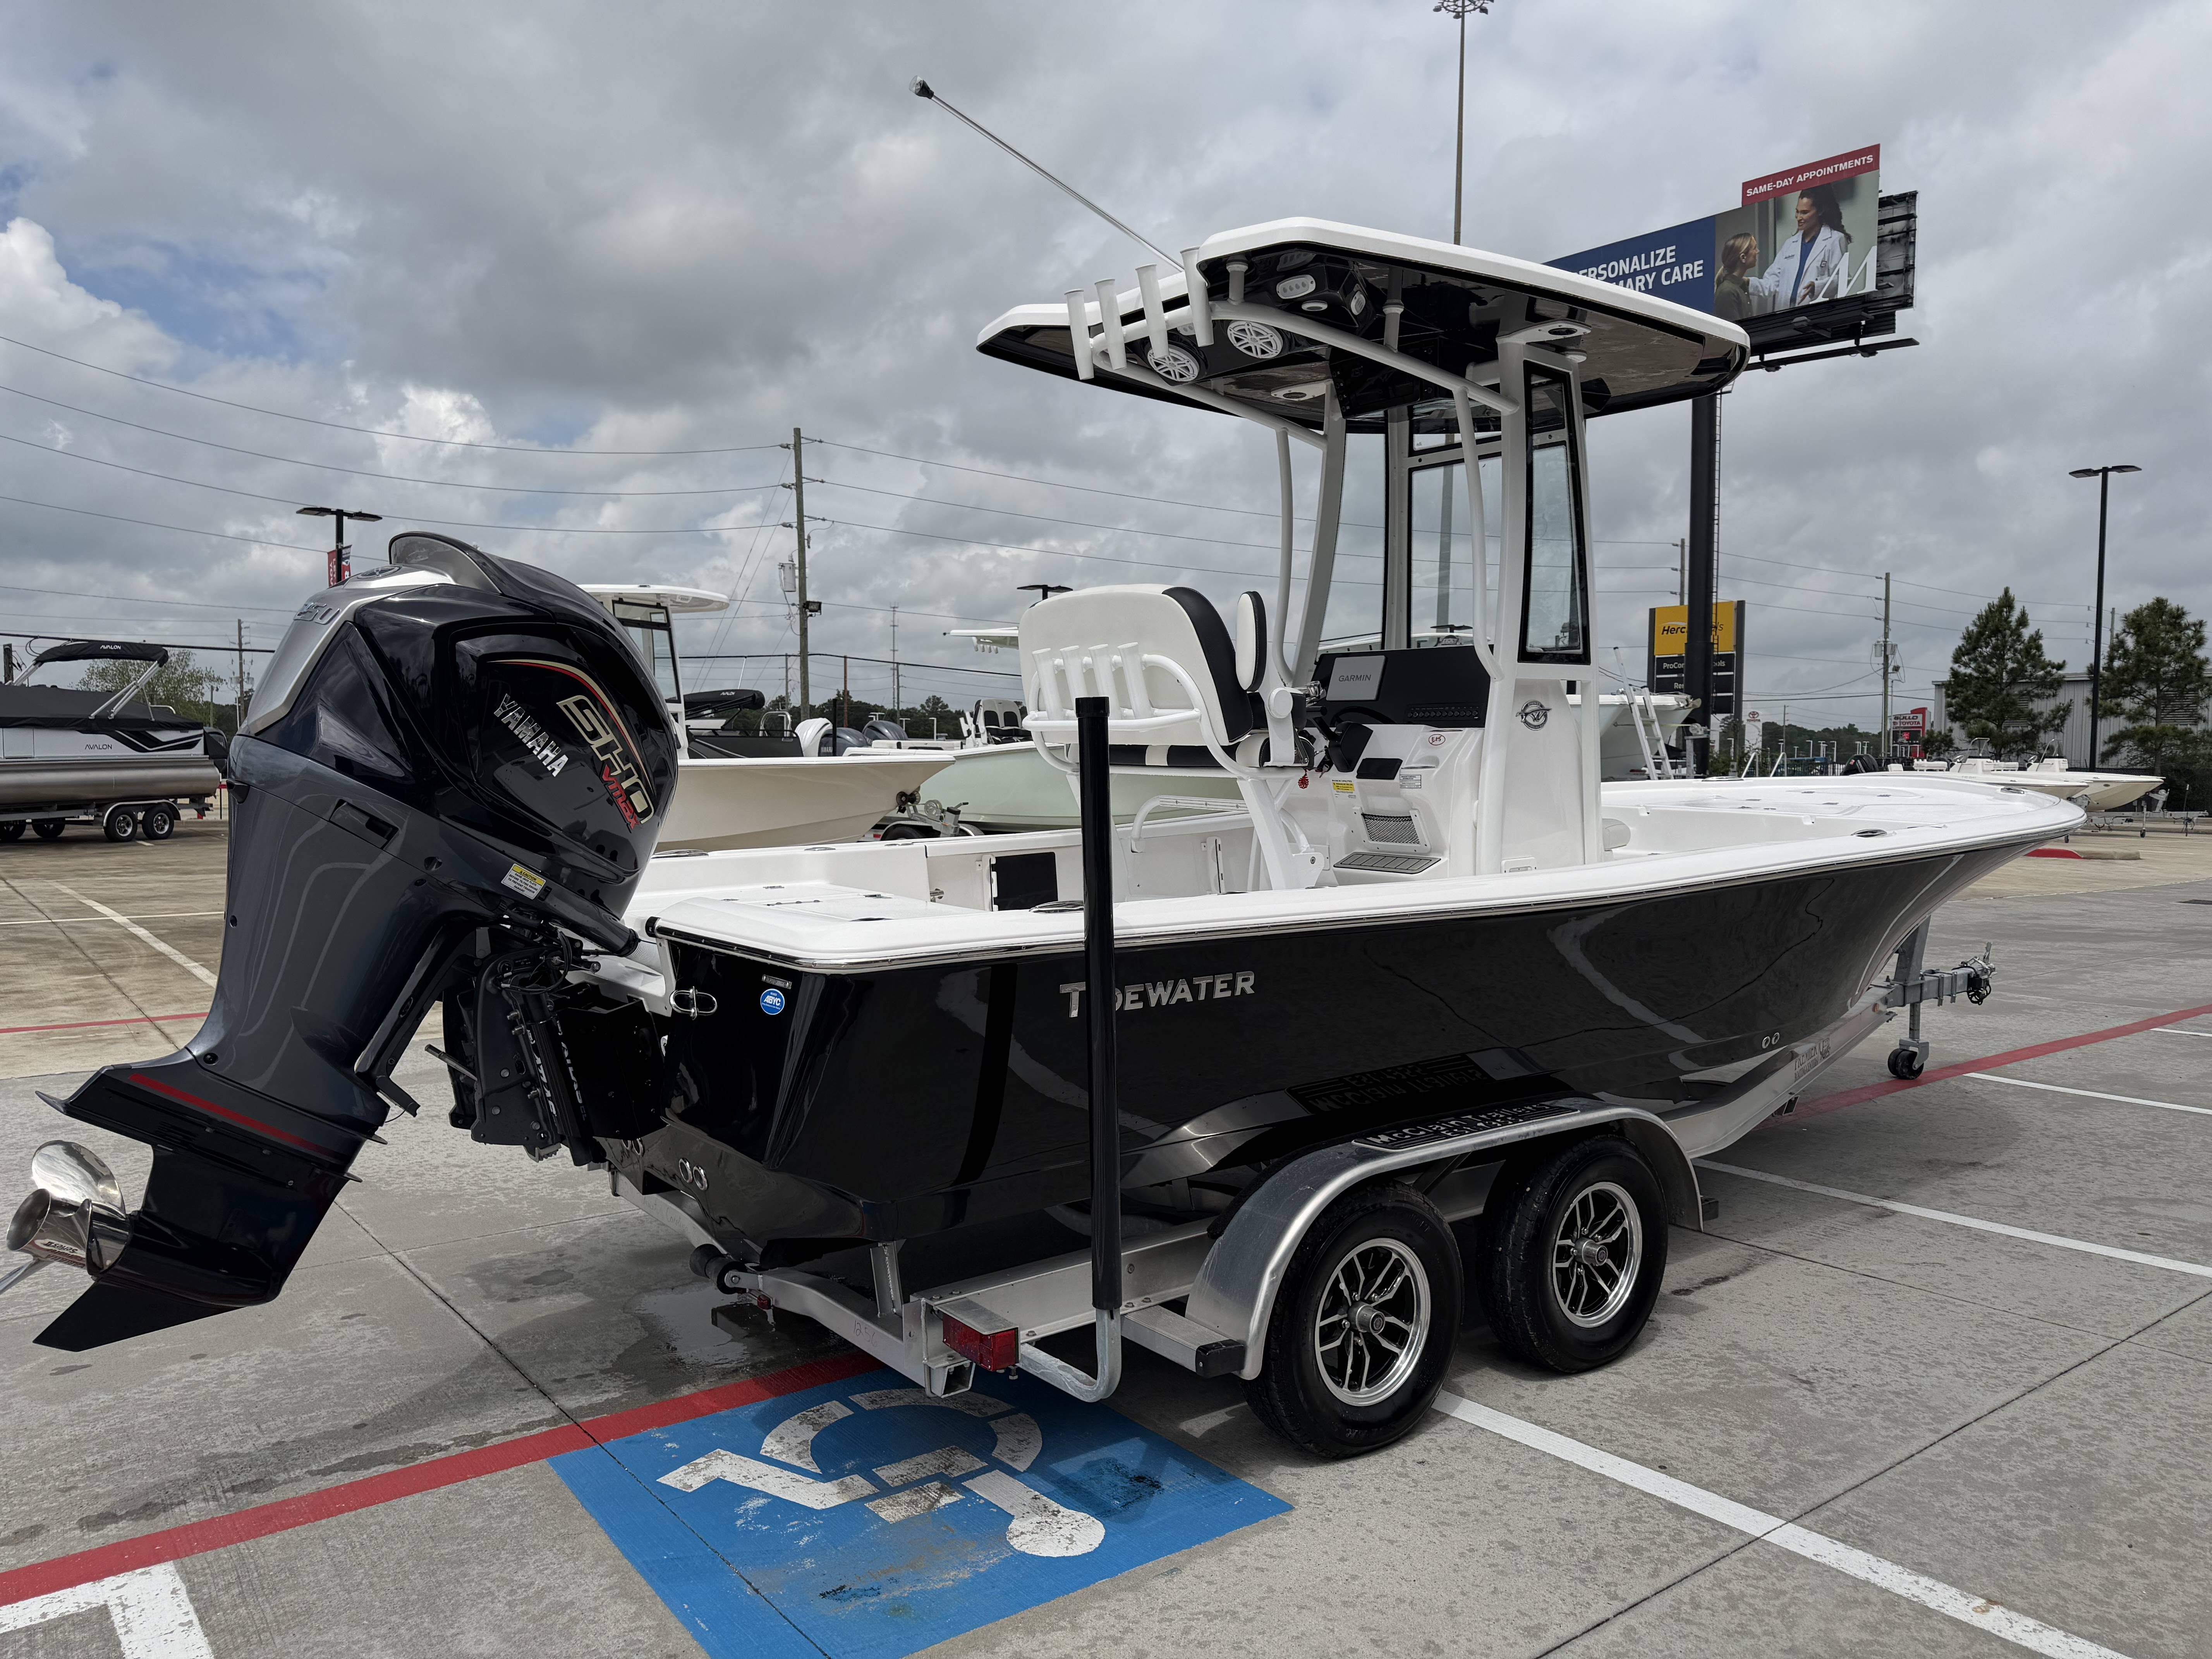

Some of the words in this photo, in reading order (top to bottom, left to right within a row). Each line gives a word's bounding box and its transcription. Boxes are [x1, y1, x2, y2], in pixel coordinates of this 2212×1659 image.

[1747, 176, 1794, 197] SAME-DAY
[1796, 155, 1874, 183] APPOINTMENTS
[1661, 260, 1704, 286] CARE
[493, 693, 570, 777] YAMAHA
[556, 694, 655, 824] SHO
[522, 871, 537, 881] CAUTION
[764, 995, 781, 1006] ABYC
[1059, 971, 1255, 1018] TEWATER
[1365, 1120, 1468, 1144] McClain
[52, 1243, 78, 1253] Series
